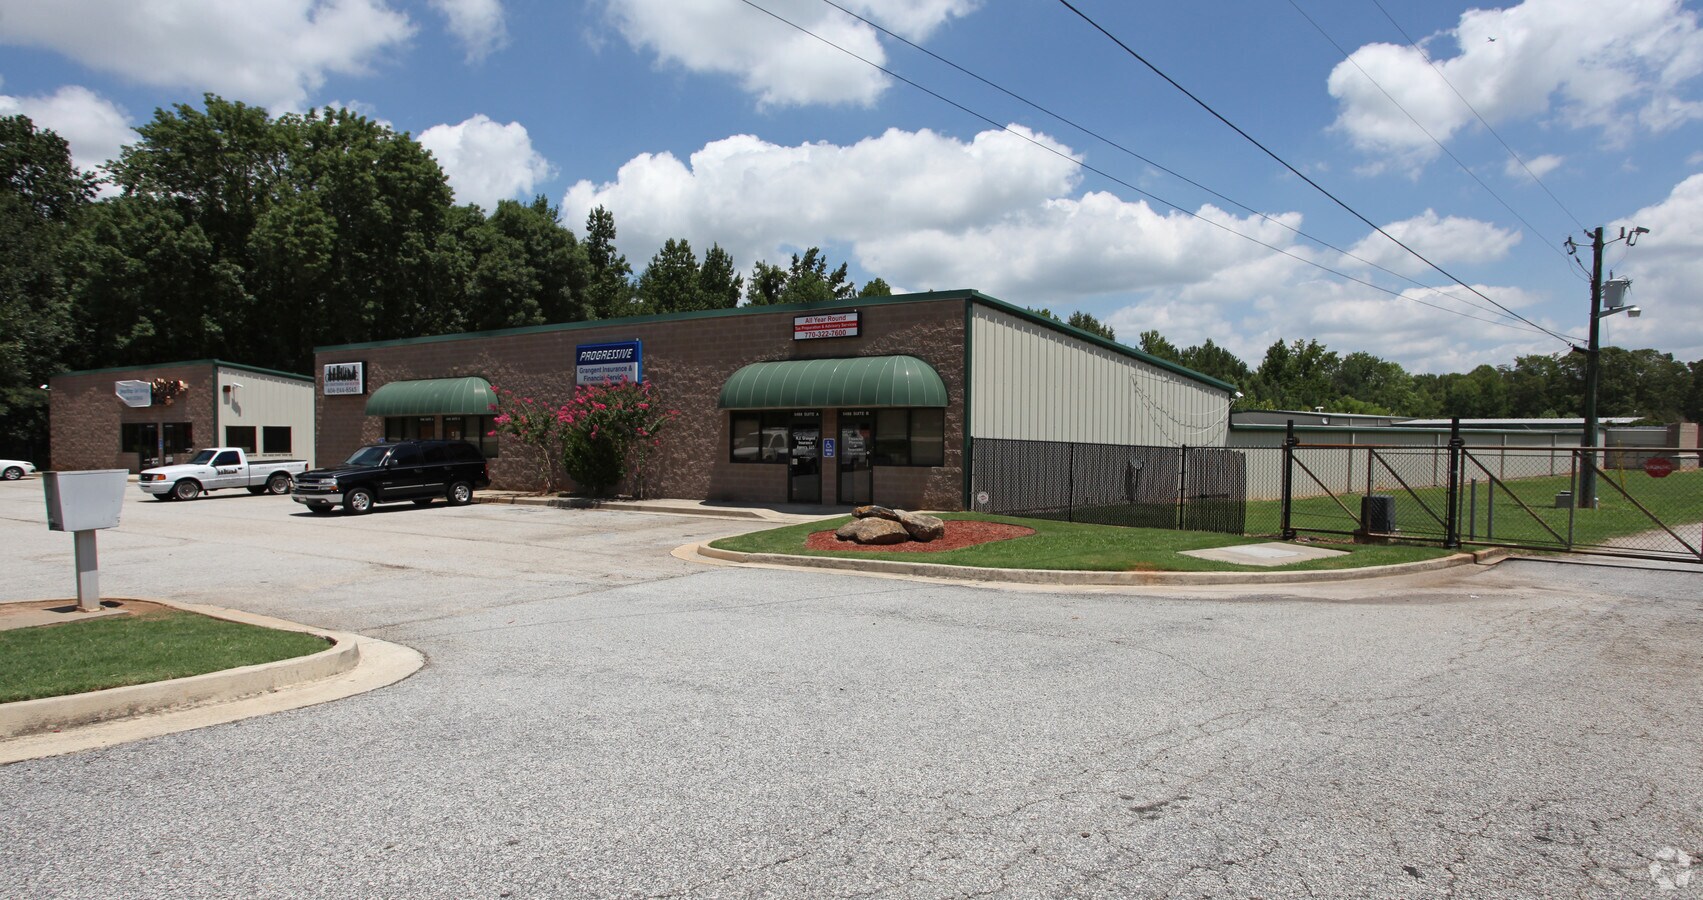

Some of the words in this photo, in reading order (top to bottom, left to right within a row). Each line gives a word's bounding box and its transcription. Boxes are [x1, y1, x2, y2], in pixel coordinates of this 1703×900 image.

[804, 330, 847, 338] 770-322-7600
[579, 348, 633, 361] PROGRESSIVE
[579, 366, 602, 375] Grangent
[602, 365, 628, 373] Insurance
[628, 364, 633, 372] &
